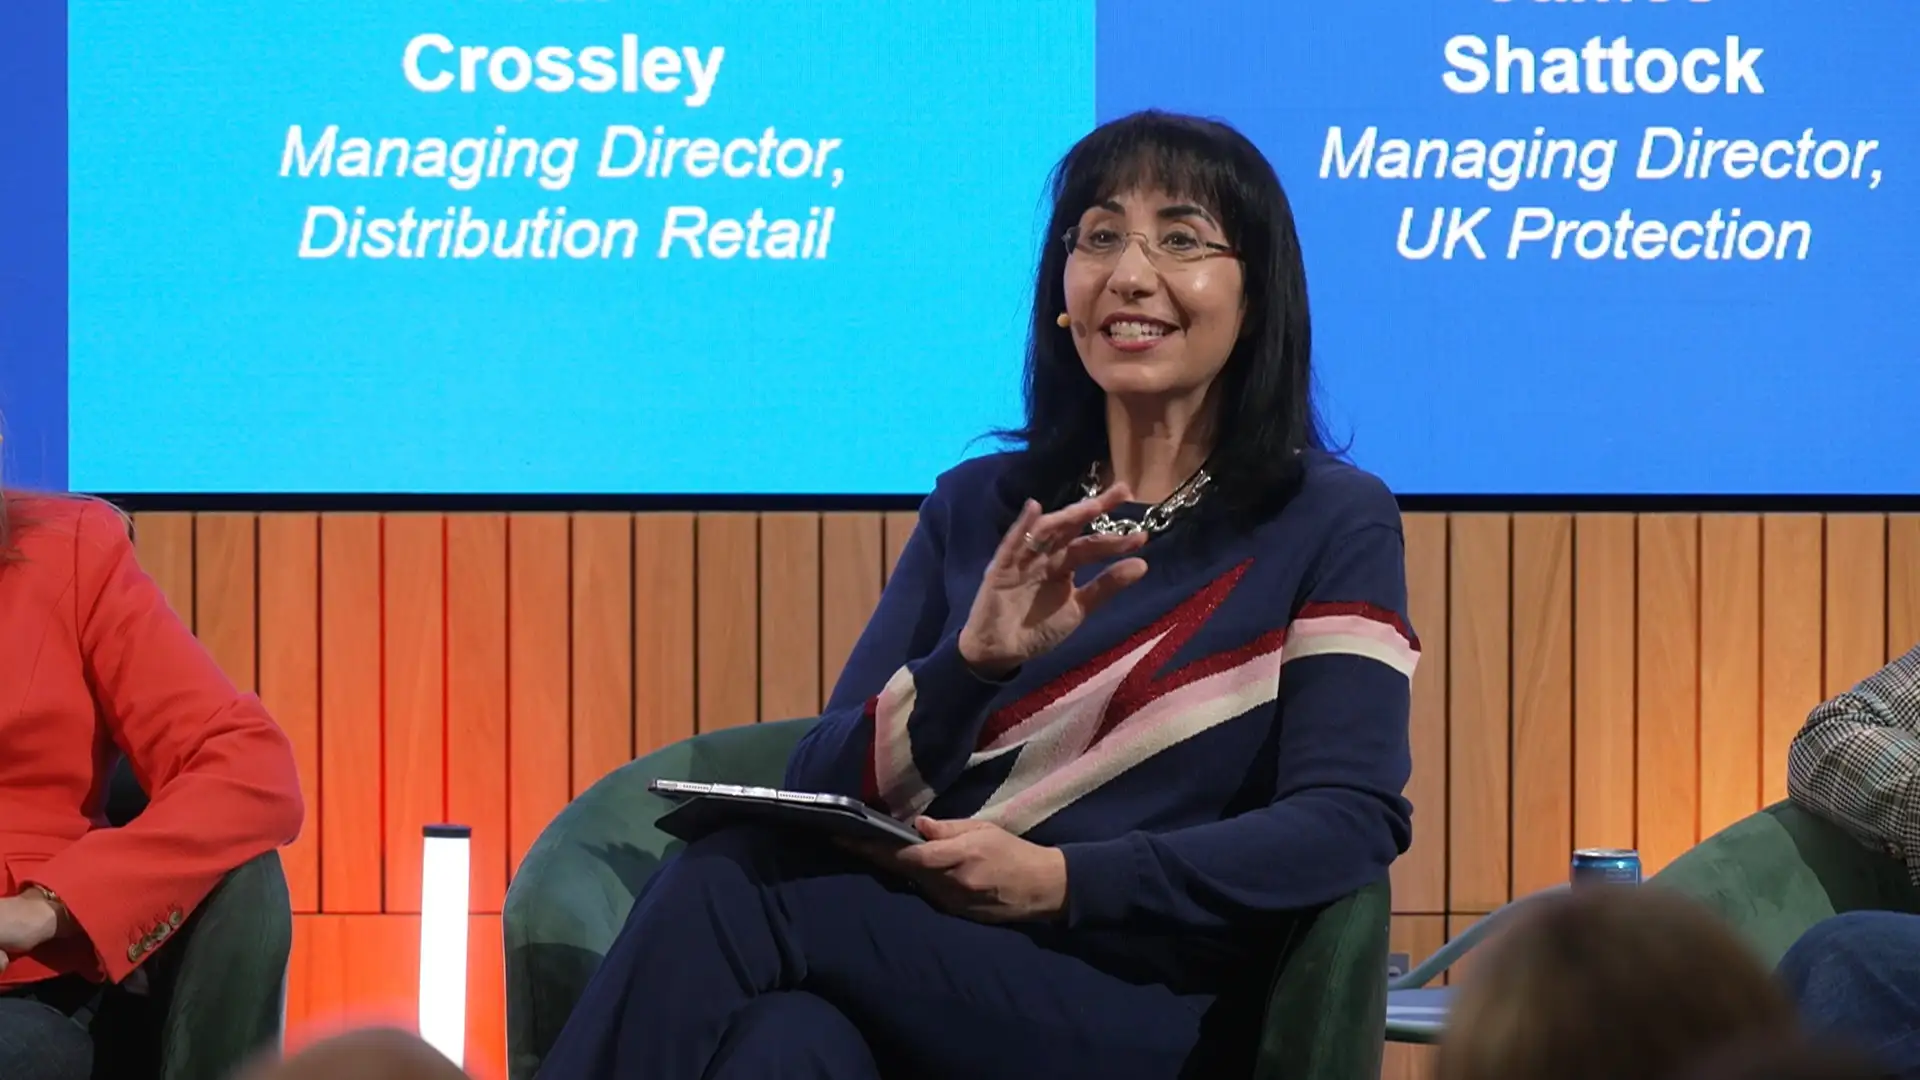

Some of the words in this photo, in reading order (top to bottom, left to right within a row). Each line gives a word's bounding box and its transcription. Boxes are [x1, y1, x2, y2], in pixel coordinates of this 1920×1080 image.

[402, 33, 725, 108] Crossley
[1442, 34, 1765, 95] Shattock
[280, 125, 578, 190] Managing
[597, 125, 845, 188] Director,
[1319, 127, 1617, 192] Managing
[1636, 127, 1882, 189] Director,
[298, 206, 638, 260] Distribution
[658, 206, 835, 260] Retail
[1397, 207, 1491, 260] UK
[1507, 208, 1811, 260] Protection
